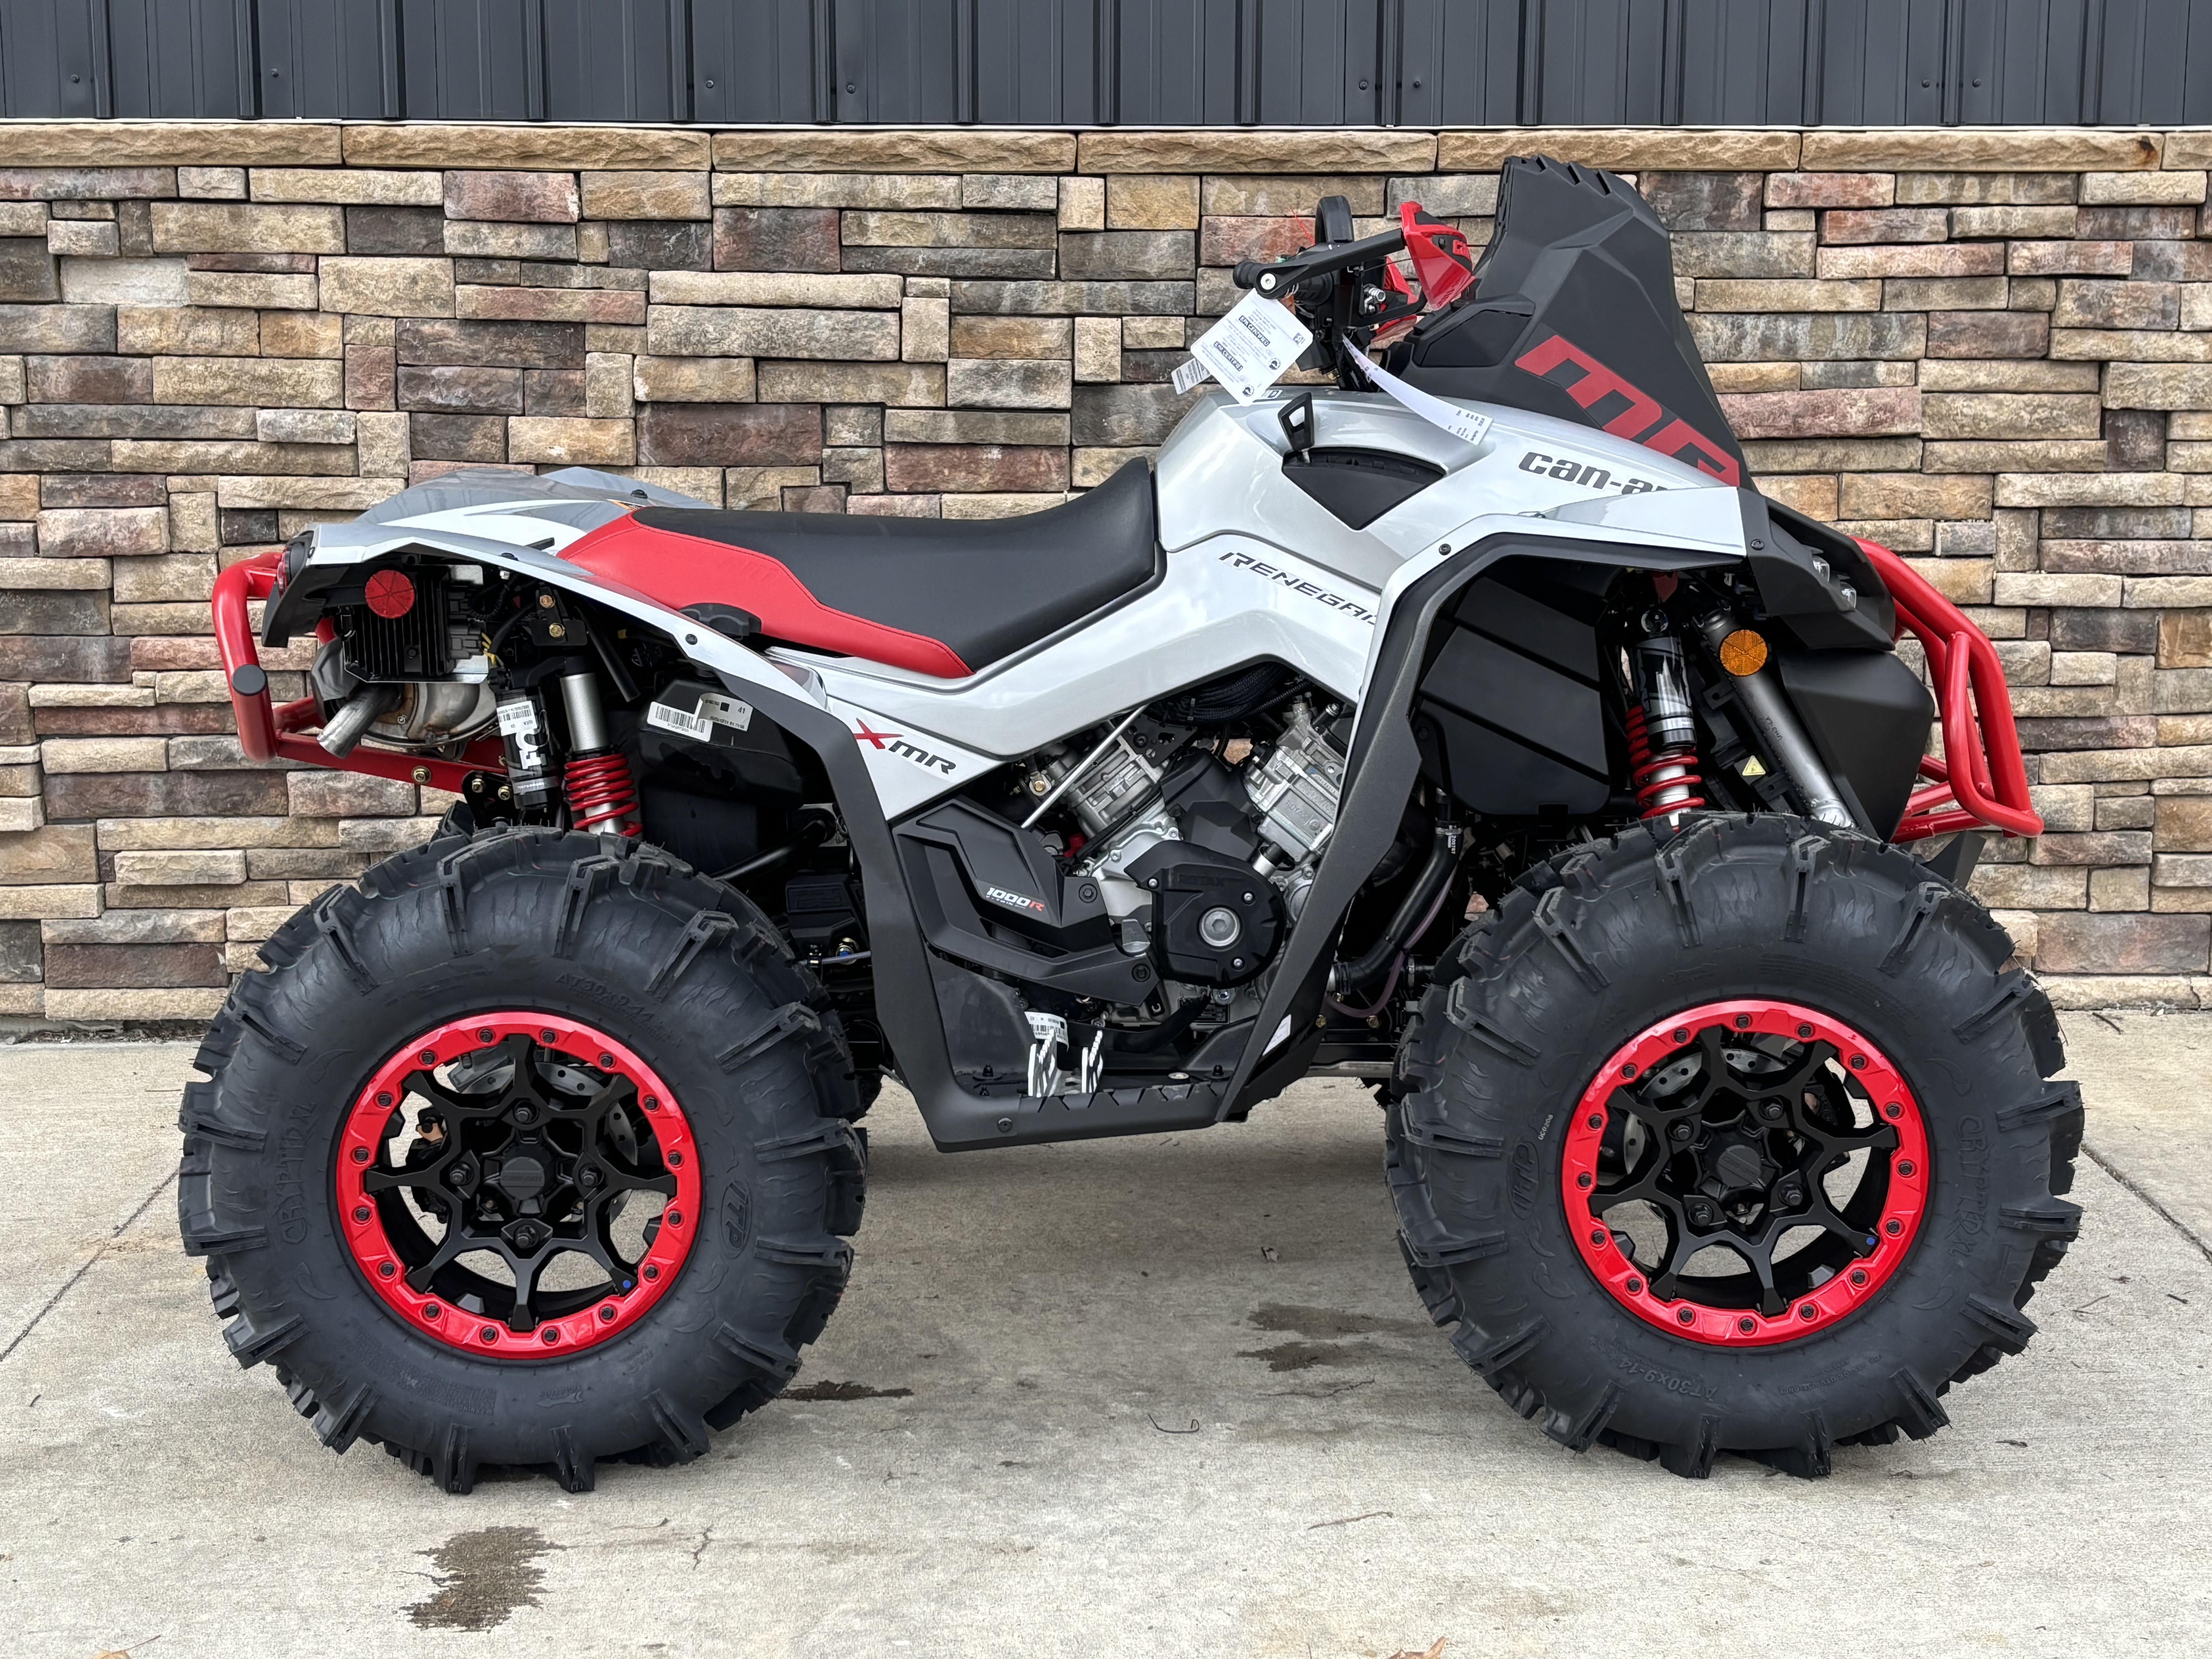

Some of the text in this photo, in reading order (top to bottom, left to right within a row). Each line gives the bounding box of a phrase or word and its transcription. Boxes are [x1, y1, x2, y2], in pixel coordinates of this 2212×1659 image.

[1520, 452, 1668, 495] can-a
[987, 887, 1044, 912] 1000R
[725, 1182, 747, 1249] ITP
[1618, 1358, 1718, 1398] AT30x9-14
